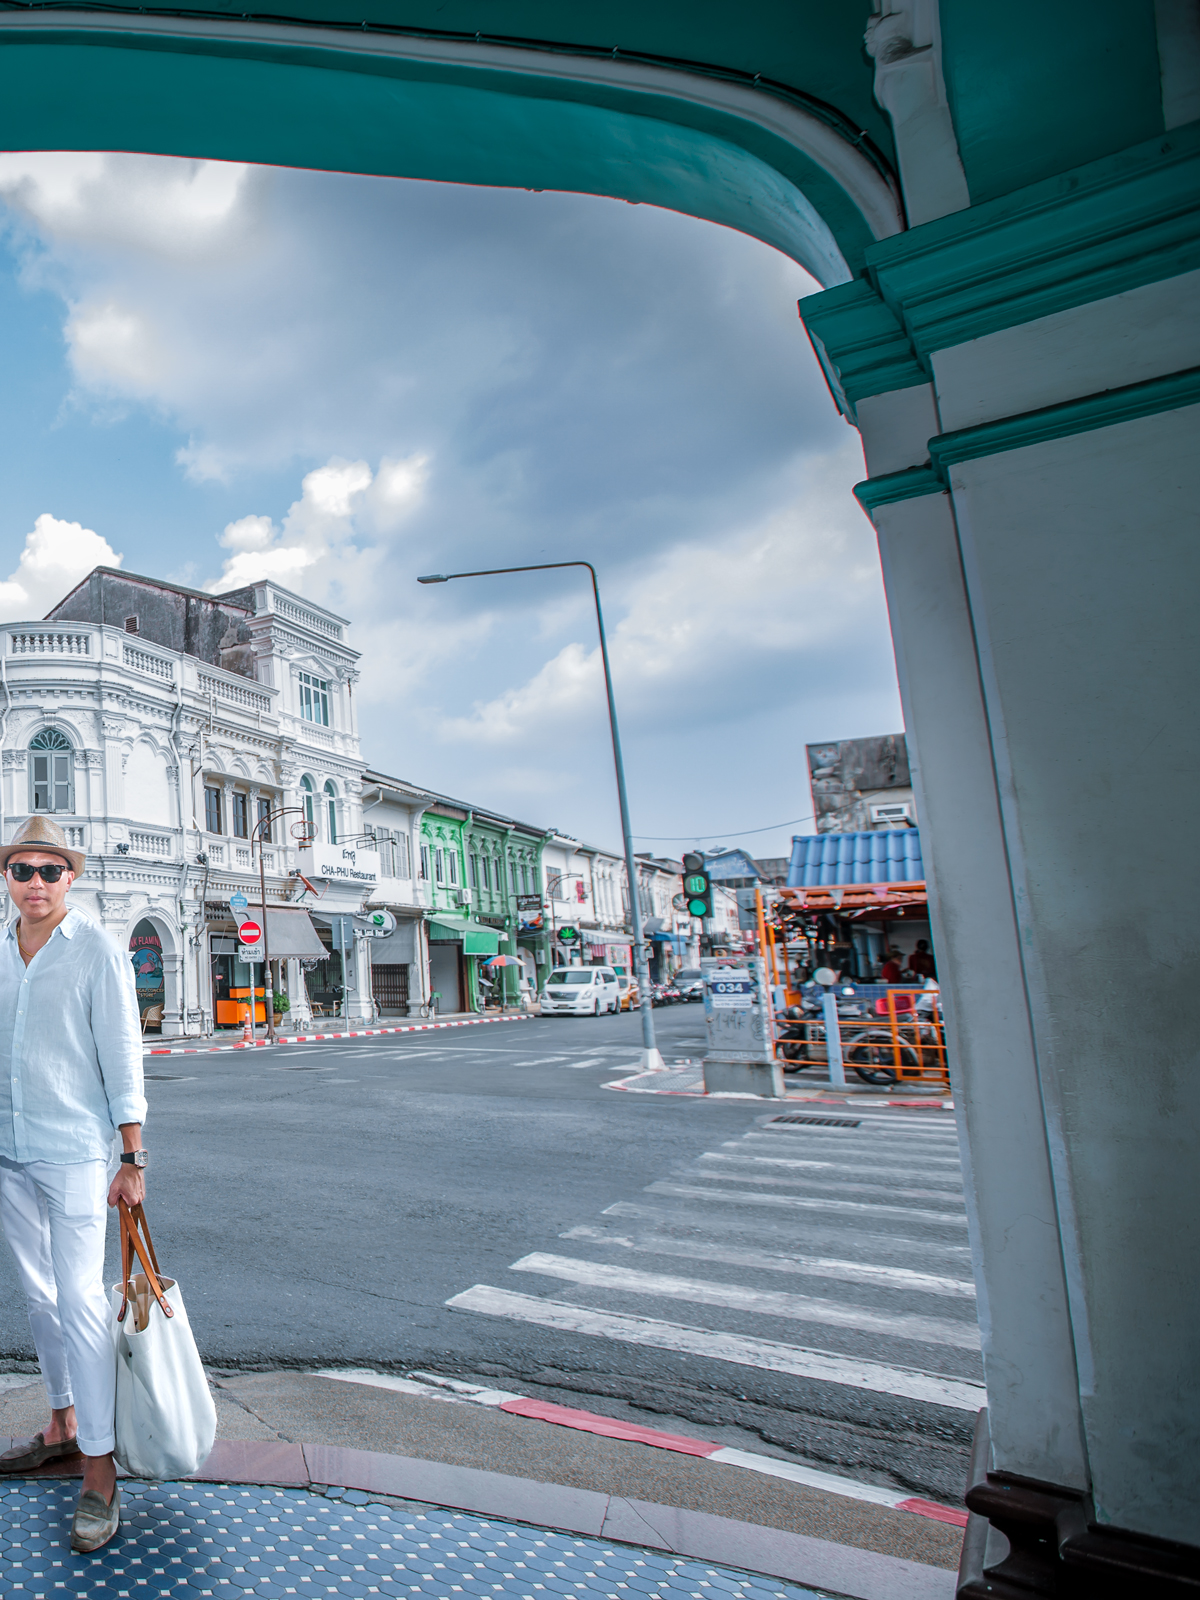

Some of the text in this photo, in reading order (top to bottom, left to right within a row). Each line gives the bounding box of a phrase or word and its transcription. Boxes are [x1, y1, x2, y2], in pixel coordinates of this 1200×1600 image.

[321, 864, 377, 882] CHA-PHU Restaurant
[690, 876, 705, 893] 10
[716, 983, 744, 993] 034
